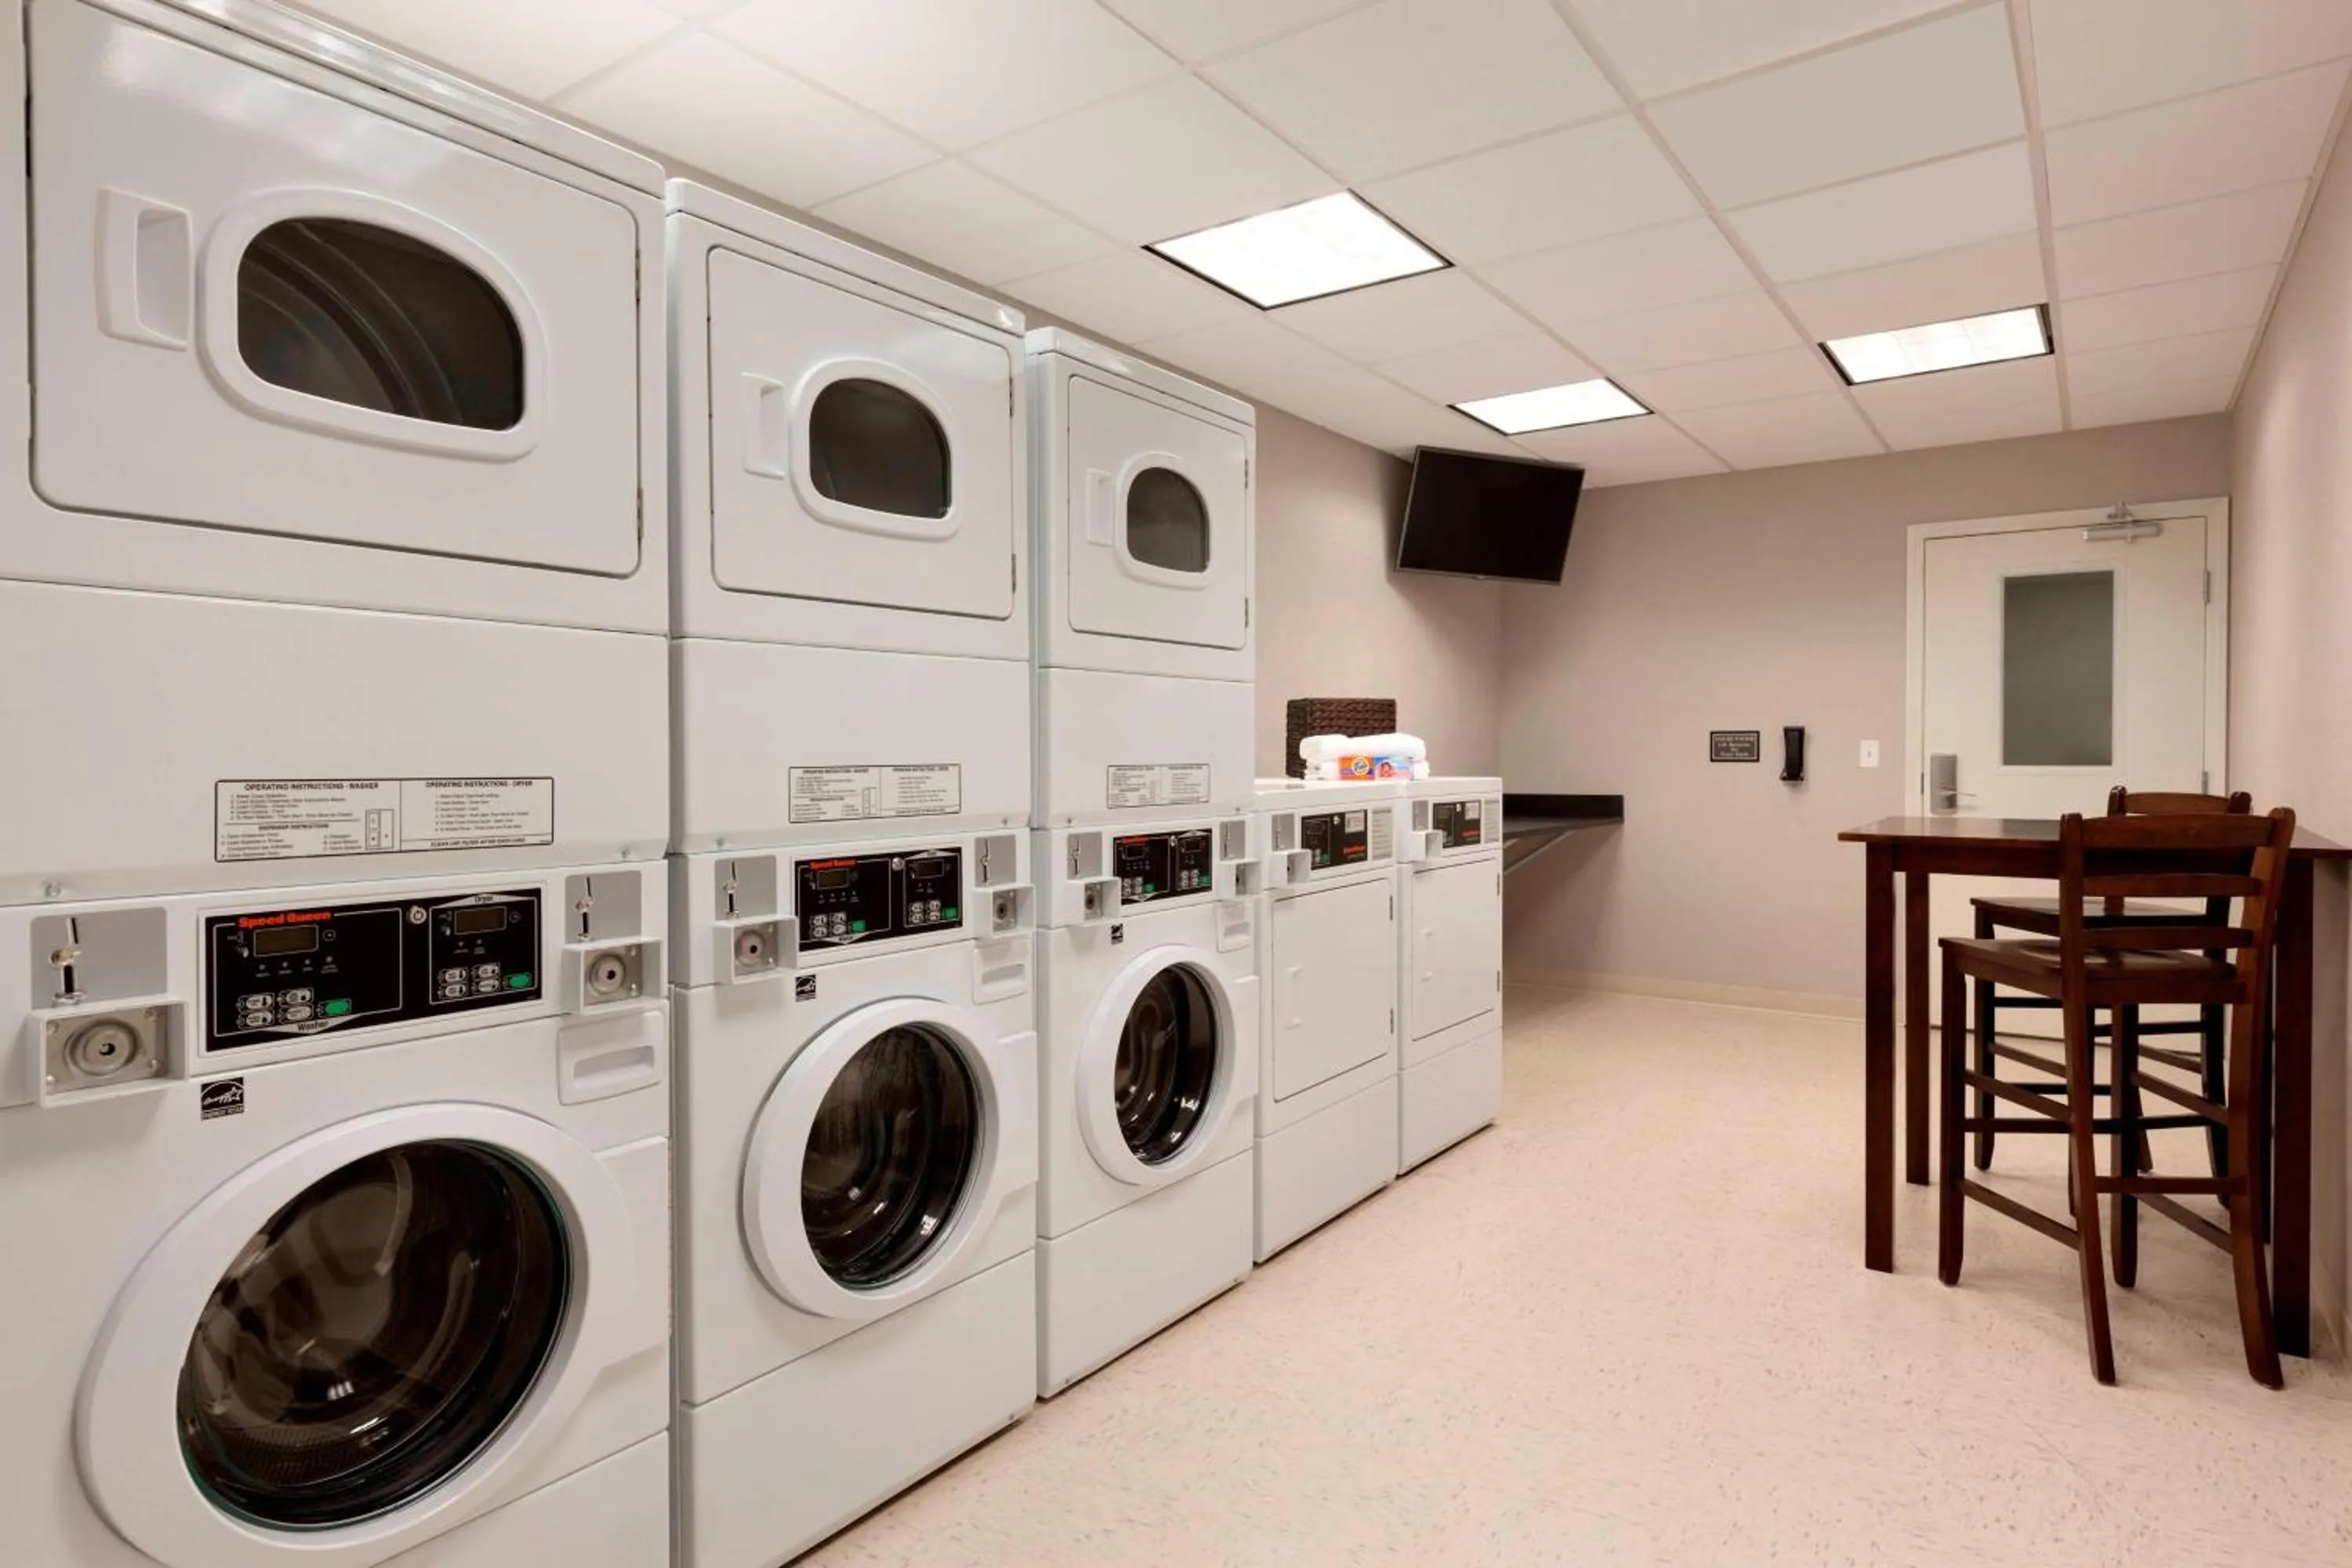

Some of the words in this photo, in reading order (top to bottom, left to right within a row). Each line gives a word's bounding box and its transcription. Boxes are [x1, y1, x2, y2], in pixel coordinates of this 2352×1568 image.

[238, 913, 285, 929] Speed
[287, 911, 332, 923] Queen
[297, 1021, 328, 1031] Washer
